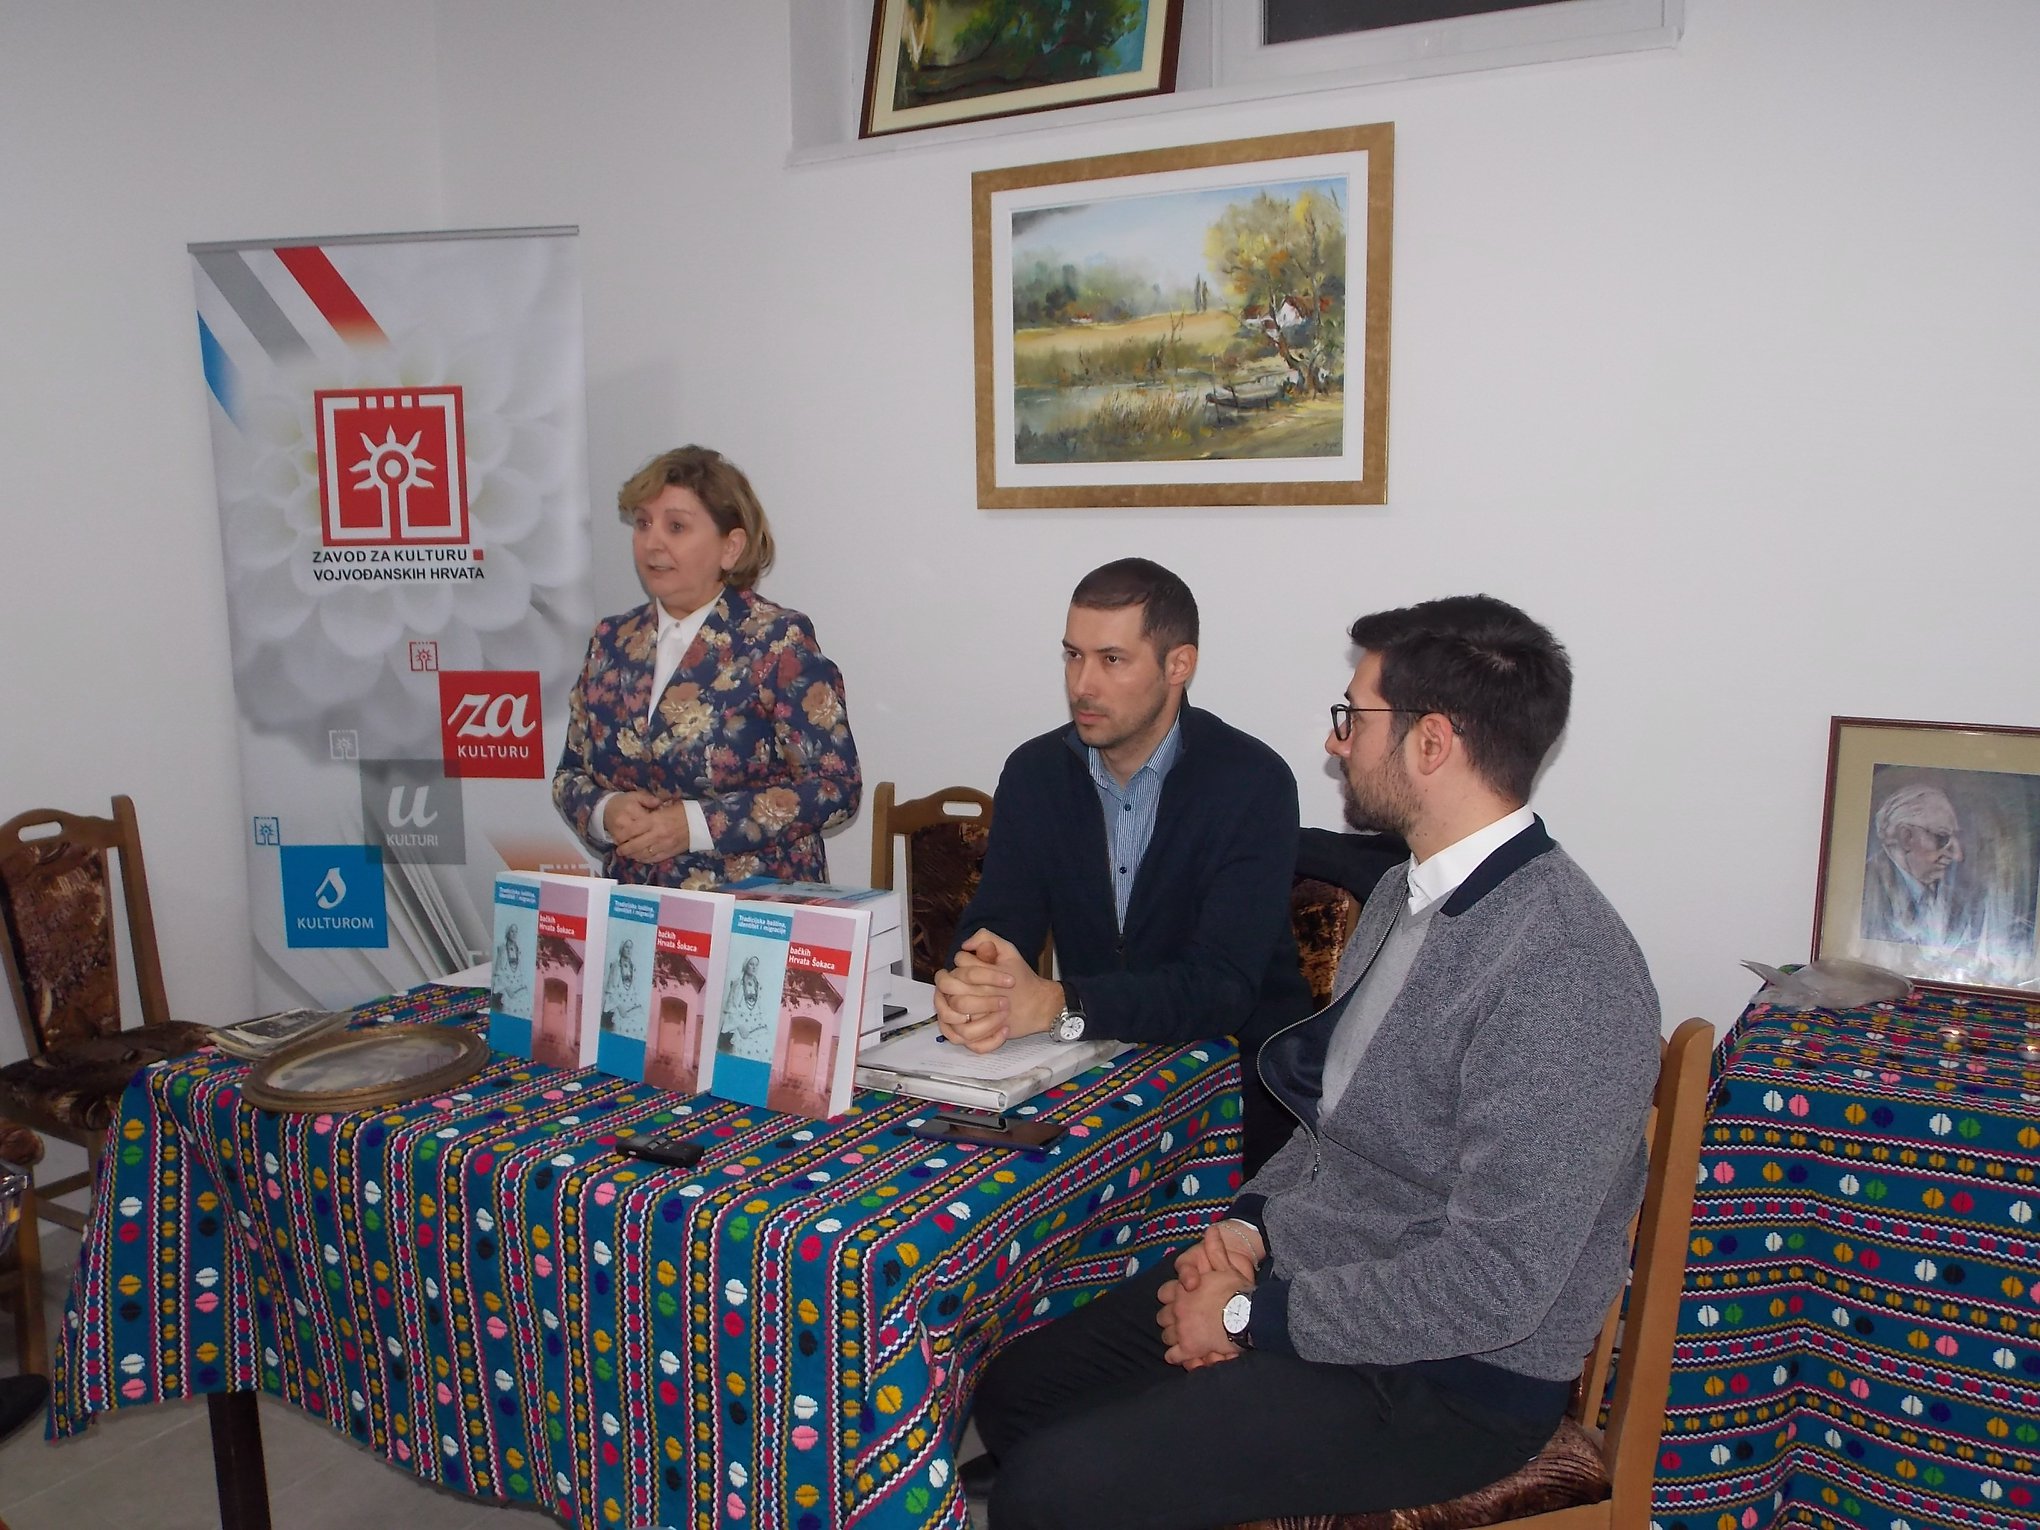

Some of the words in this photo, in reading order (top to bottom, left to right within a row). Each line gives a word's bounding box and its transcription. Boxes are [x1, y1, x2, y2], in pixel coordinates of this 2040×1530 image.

[312, 550, 367, 563] ZAVOD
[370, 550, 391, 562] ZA
[394, 548, 467, 562] KULTURU
[313, 568, 426, 581] VOJVOĐANSKIH
[430, 567, 485, 580] HRVATA
[447, 693, 536, 738] za
[457, 745, 529, 758] KULTURU
[387, 785, 438, 828] u
[386, 833, 438, 847] KULTURI
[297, 917, 374, 929] KULTUROM
[658, 929, 676, 939] bačkih
[657, 939, 675, 949] Hrvata
[676, 939, 697, 952] Šokaca
[789, 946, 811, 957] bačkih
[788, 955, 810, 966] Hrvata
[811, 956, 835, 970] Šokaca
